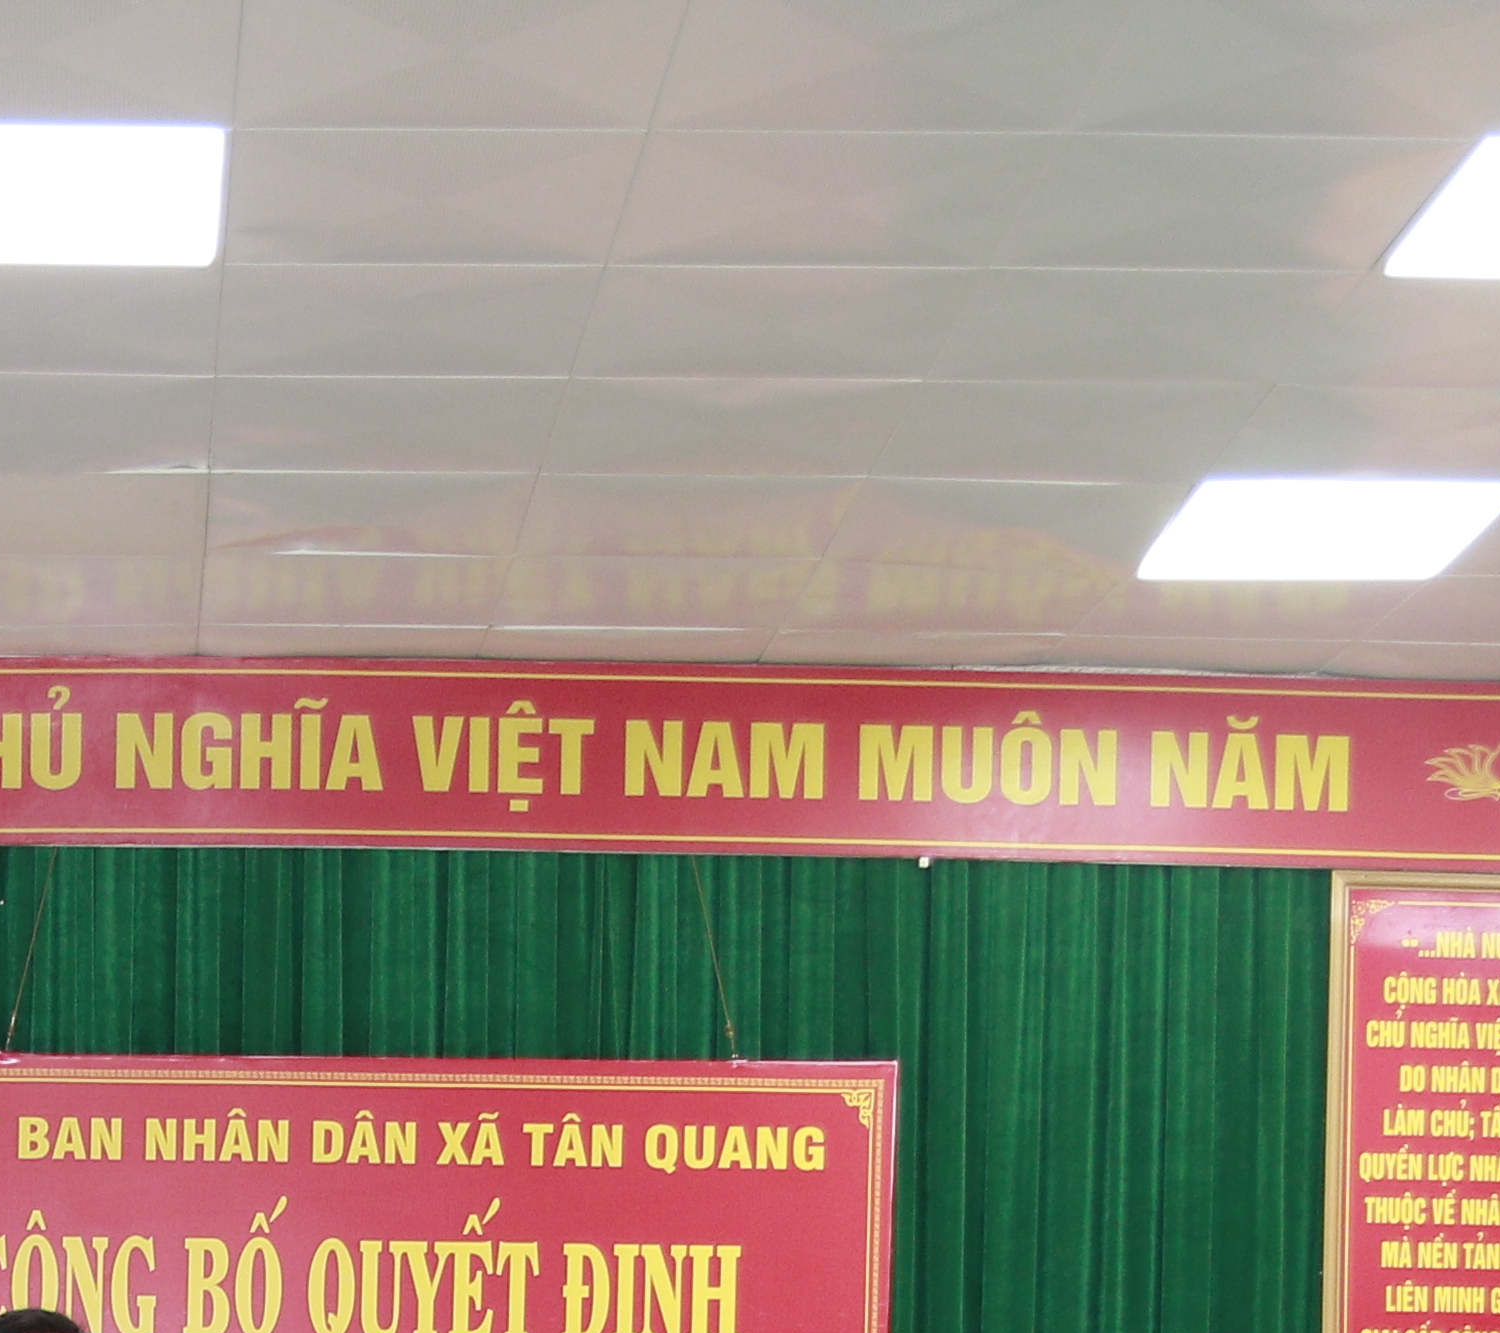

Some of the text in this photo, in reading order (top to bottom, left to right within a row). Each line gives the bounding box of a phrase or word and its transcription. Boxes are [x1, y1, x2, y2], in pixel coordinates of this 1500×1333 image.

[116, 698, 383, 790] NGHĨA
[413, 701, 594, 811] VIỆT
[625, 720, 824, 799] NAM
[859, 711, 1119, 806] MUÔN
[1150, 715, 1350, 812] NĂM
[1383, 972, 1437, 1009] CỘNG
[1442, 974, 1482, 1005] HÒA
[1366, 1010, 1405, 1048] CHỦ
[1410, 1017, 1471, 1049] NGHĨA
[1399, 1064, 1426, 1092] DO
[1431, 1062, 1486, 1093] NHÂN
[1383, 1105, 1425, 1136] LÀM
[1430, 1100, 1476, 1138] CHỦ;
[18, 1117, 122, 1160] BAN
[145, 1108, 289, 1162] NHÂN
[312, 1110, 416, 1164] DÂN
[437, 1113, 504, 1165] XÃ
[523, 1113, 623, 1167] TÂN
[645, 1124, 825, 1173] QUANG
[1359, 1146, 1423, 1181] QUYỀN
[1428, 1152, 1465, 1185] LỰC
[1364, 1193, 1427, 1229] THUỘC
[1431, 1190, 1457, 1225] VỀ
[1381, 1237, 1413, 1268] MÀ
[1417, 1234, 1458, 1269] NỀN
[1386, 1280, 1429, 1312] LIÊN
[1434, 1286, 1486, 1313] MINH
